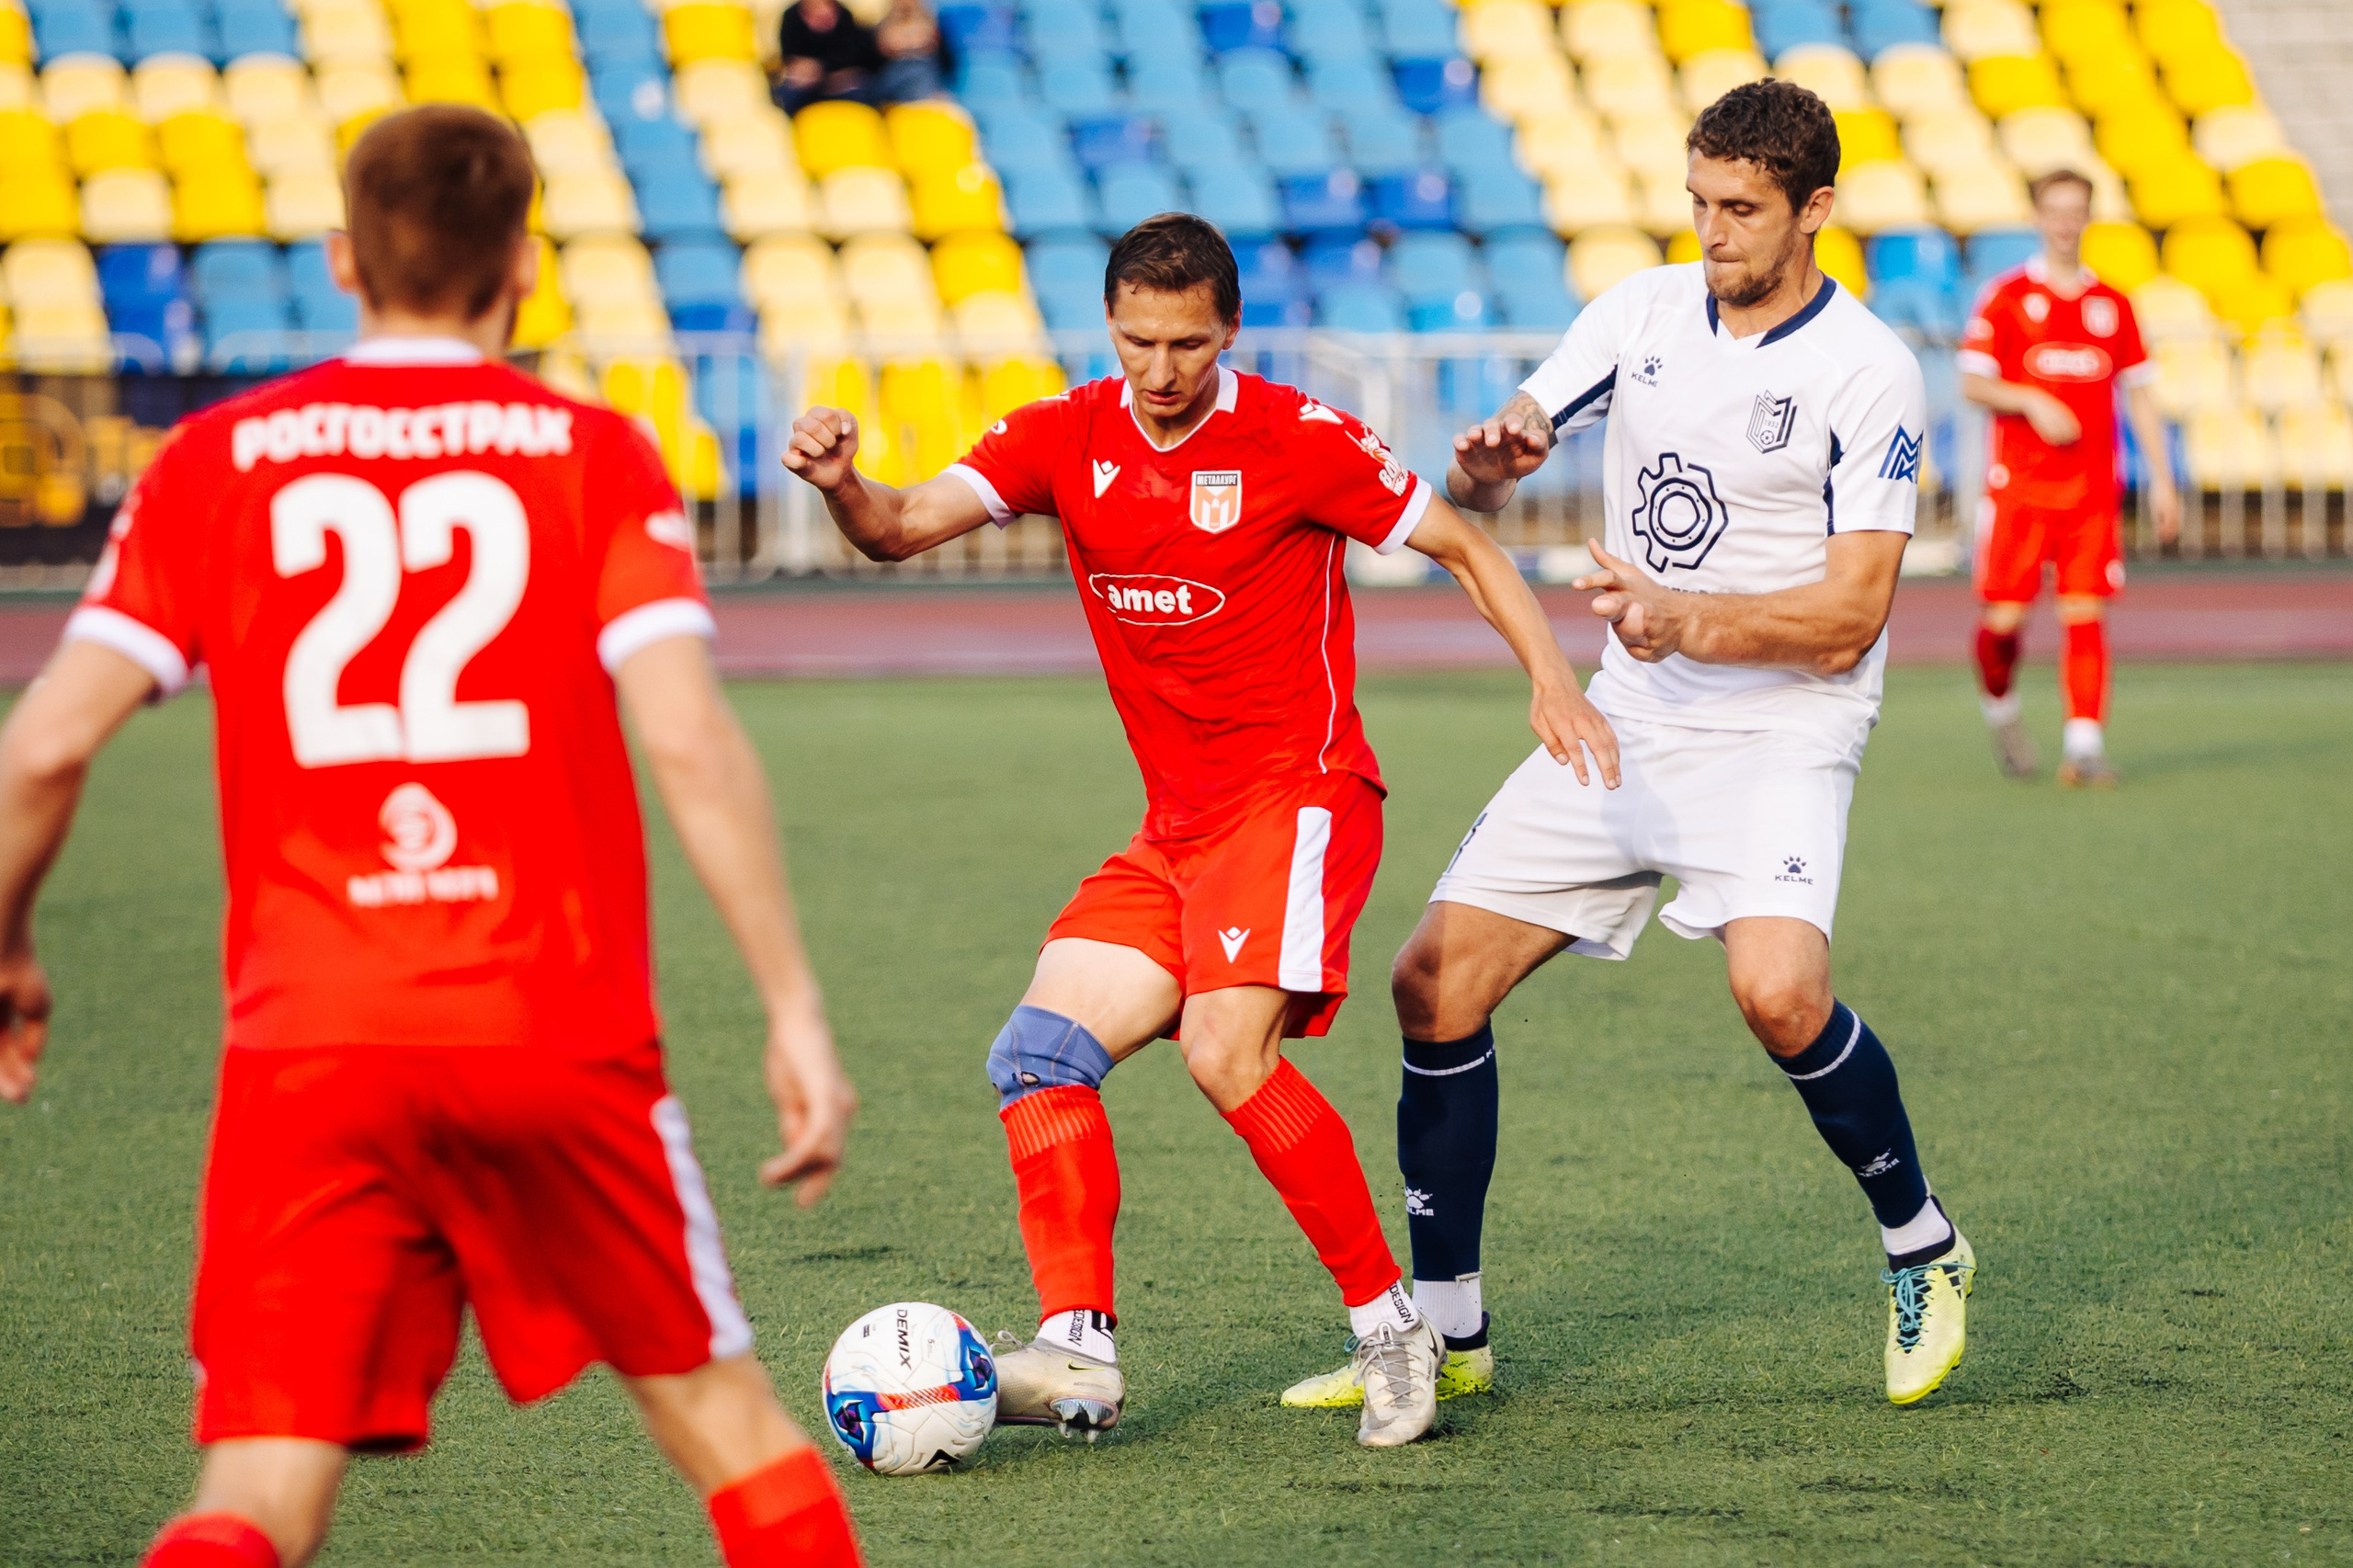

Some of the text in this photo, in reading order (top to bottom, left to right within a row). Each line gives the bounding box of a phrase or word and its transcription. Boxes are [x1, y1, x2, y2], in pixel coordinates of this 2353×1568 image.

[233, 401, 573, 472] РОСГОССТРАХ
[1197, 474, 1237, 485] МЕТАЛЛУРГ
[269, 470, 530, 770] 22
[1107, 584, 1194, 615] amet
[1774, 875, 1813, 885] KELME
[1389, 1282, 1414, 1324] DESIGN
[897, 1309, 913, 1370] DEMIX
